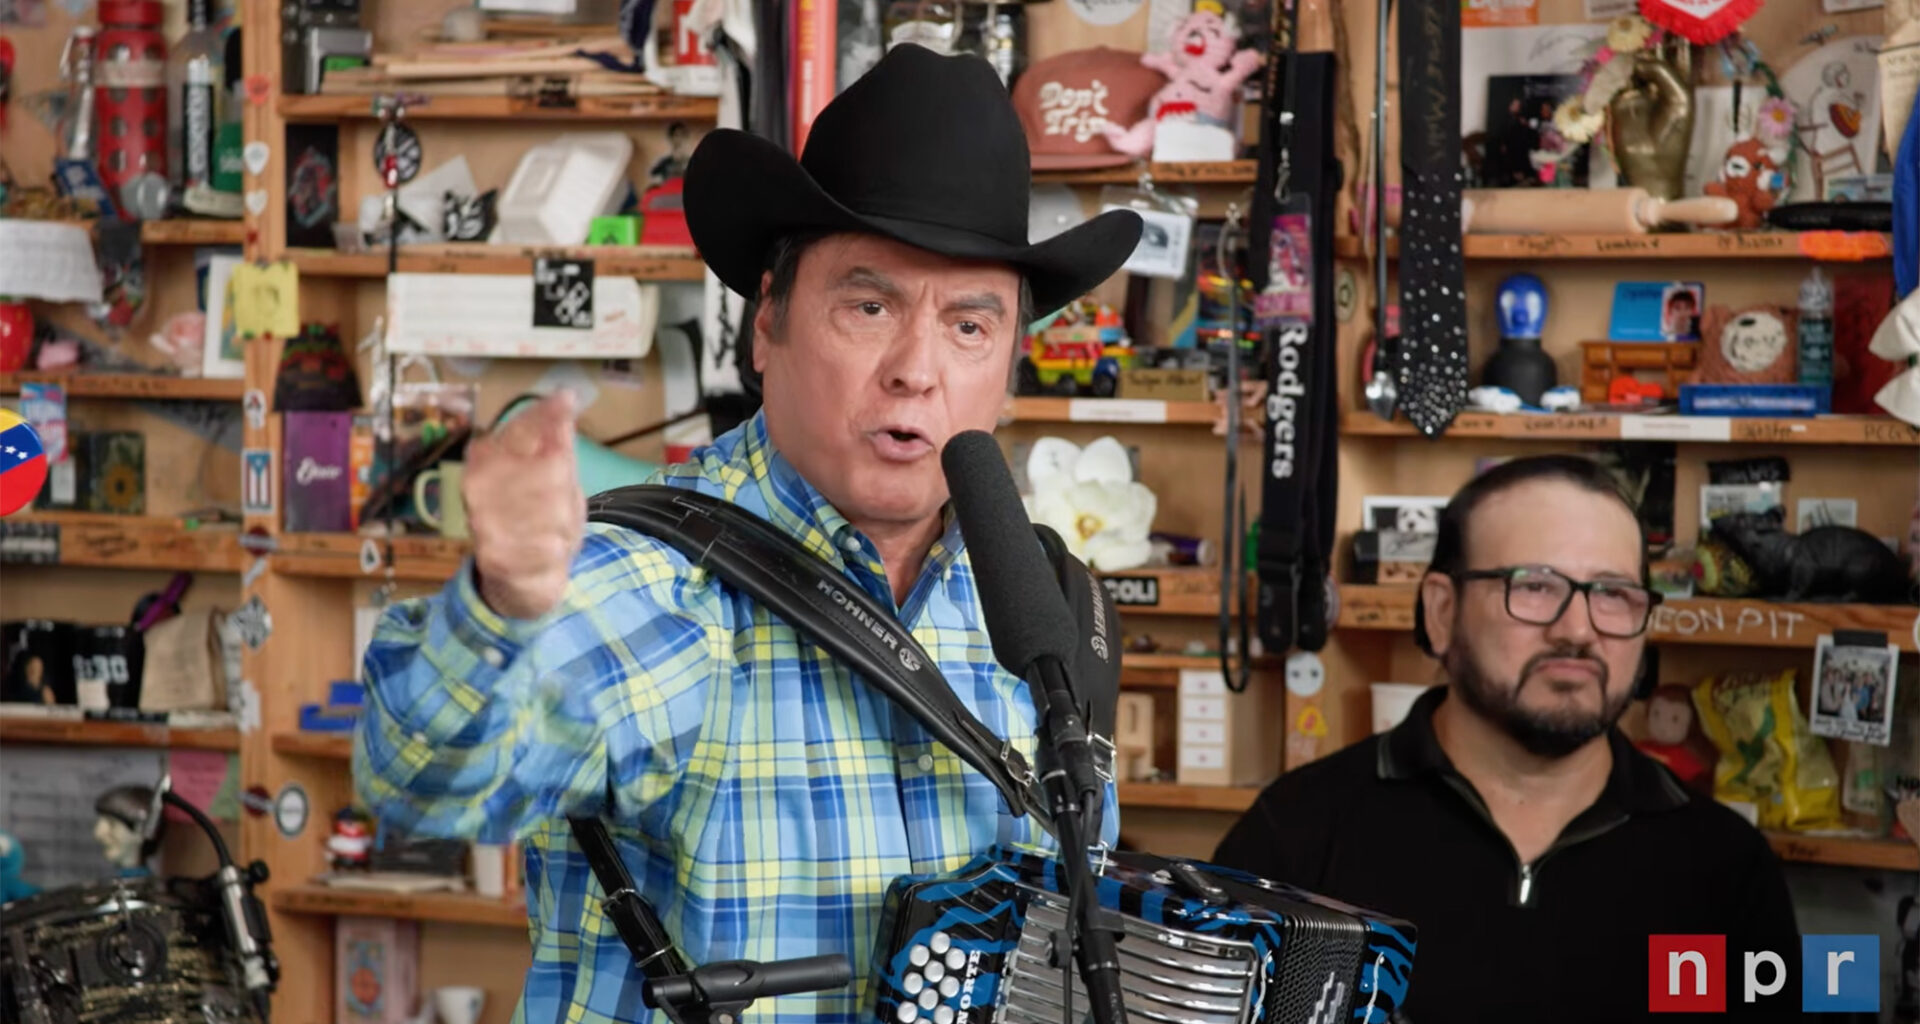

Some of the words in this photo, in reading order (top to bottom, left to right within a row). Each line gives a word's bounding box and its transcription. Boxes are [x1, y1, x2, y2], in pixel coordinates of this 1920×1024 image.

[1039, 80, 1109, 116] Don't
[1267, 322, 1308, 478] Rodgers
[816, 579, 898, 651] HOHNER
[1651, 605, 1725, 635] EON
[1736, 607, 1805, 640] PIT
[956, 949, 981, 1024] NORTE
